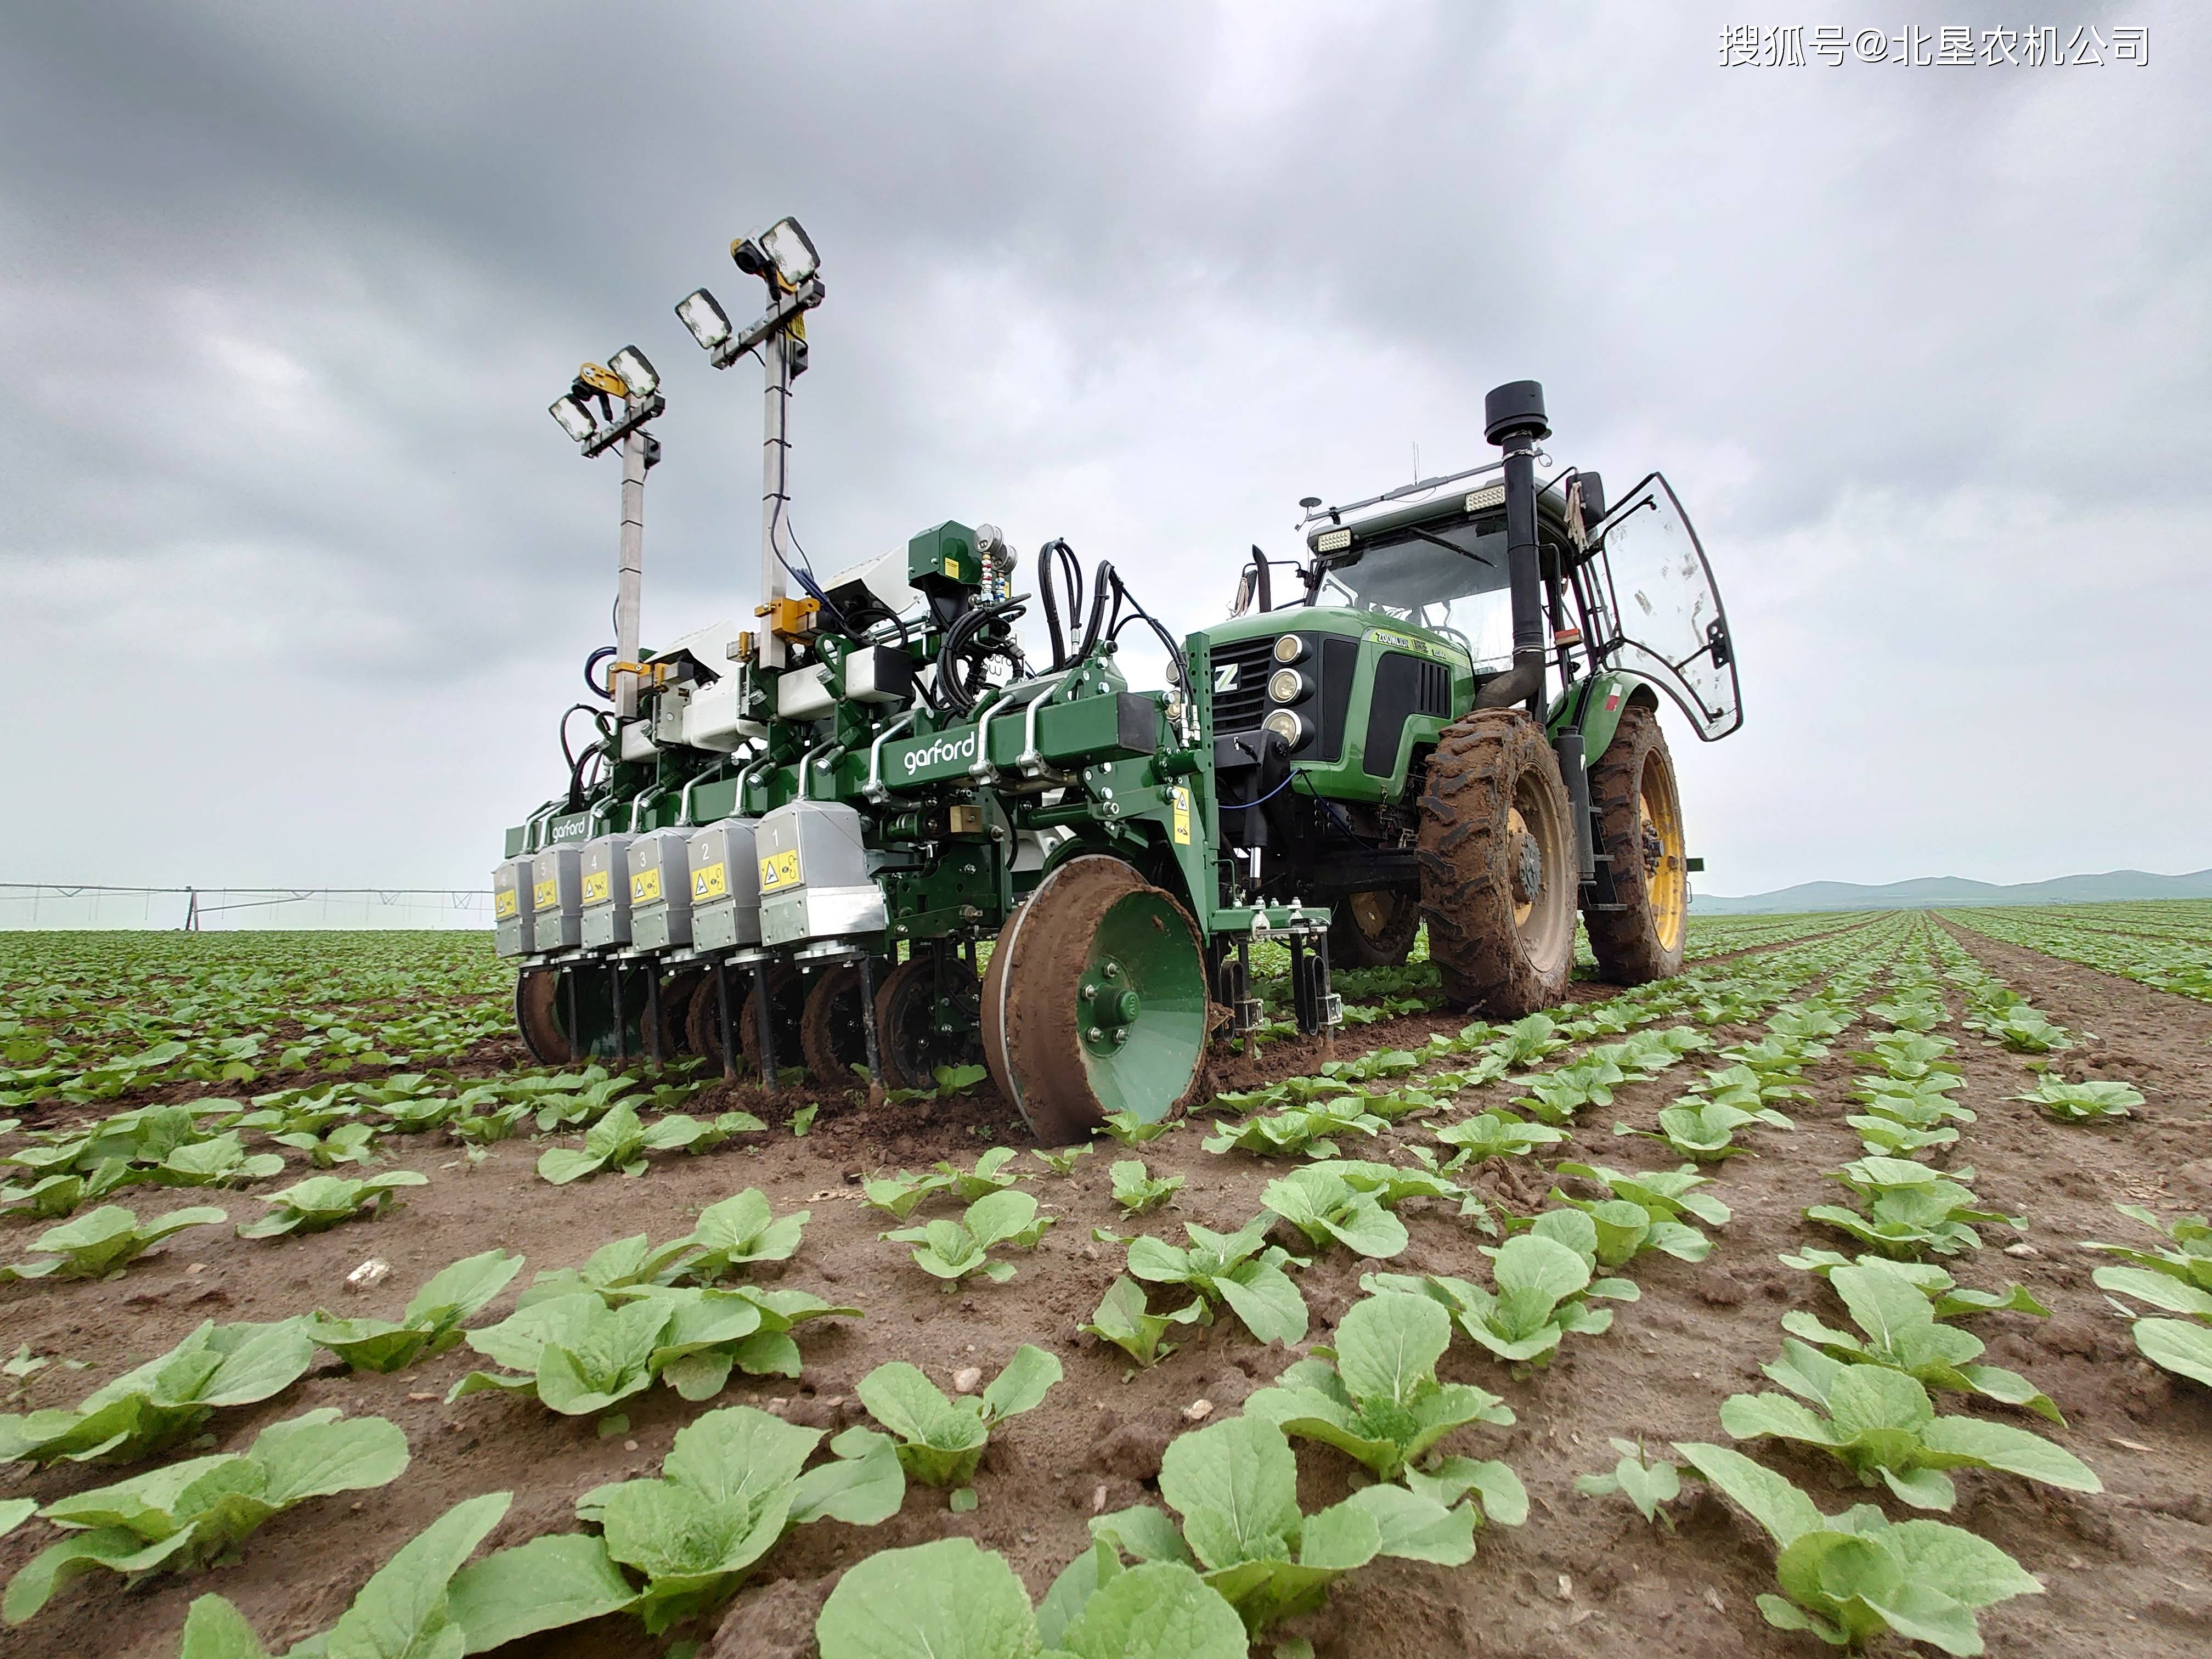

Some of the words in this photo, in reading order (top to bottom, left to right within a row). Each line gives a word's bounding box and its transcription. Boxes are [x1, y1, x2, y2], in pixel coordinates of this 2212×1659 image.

[904, 731, 975, 776] garford
[552, 816, 585, 843] garford
[772, 828, 779, 847] 1
[640, 851, 646, 867] 3
[702, 843, 709, 860] 2
[540, 862, 546, 876] 5
[591, 855, 597, 870] 4
